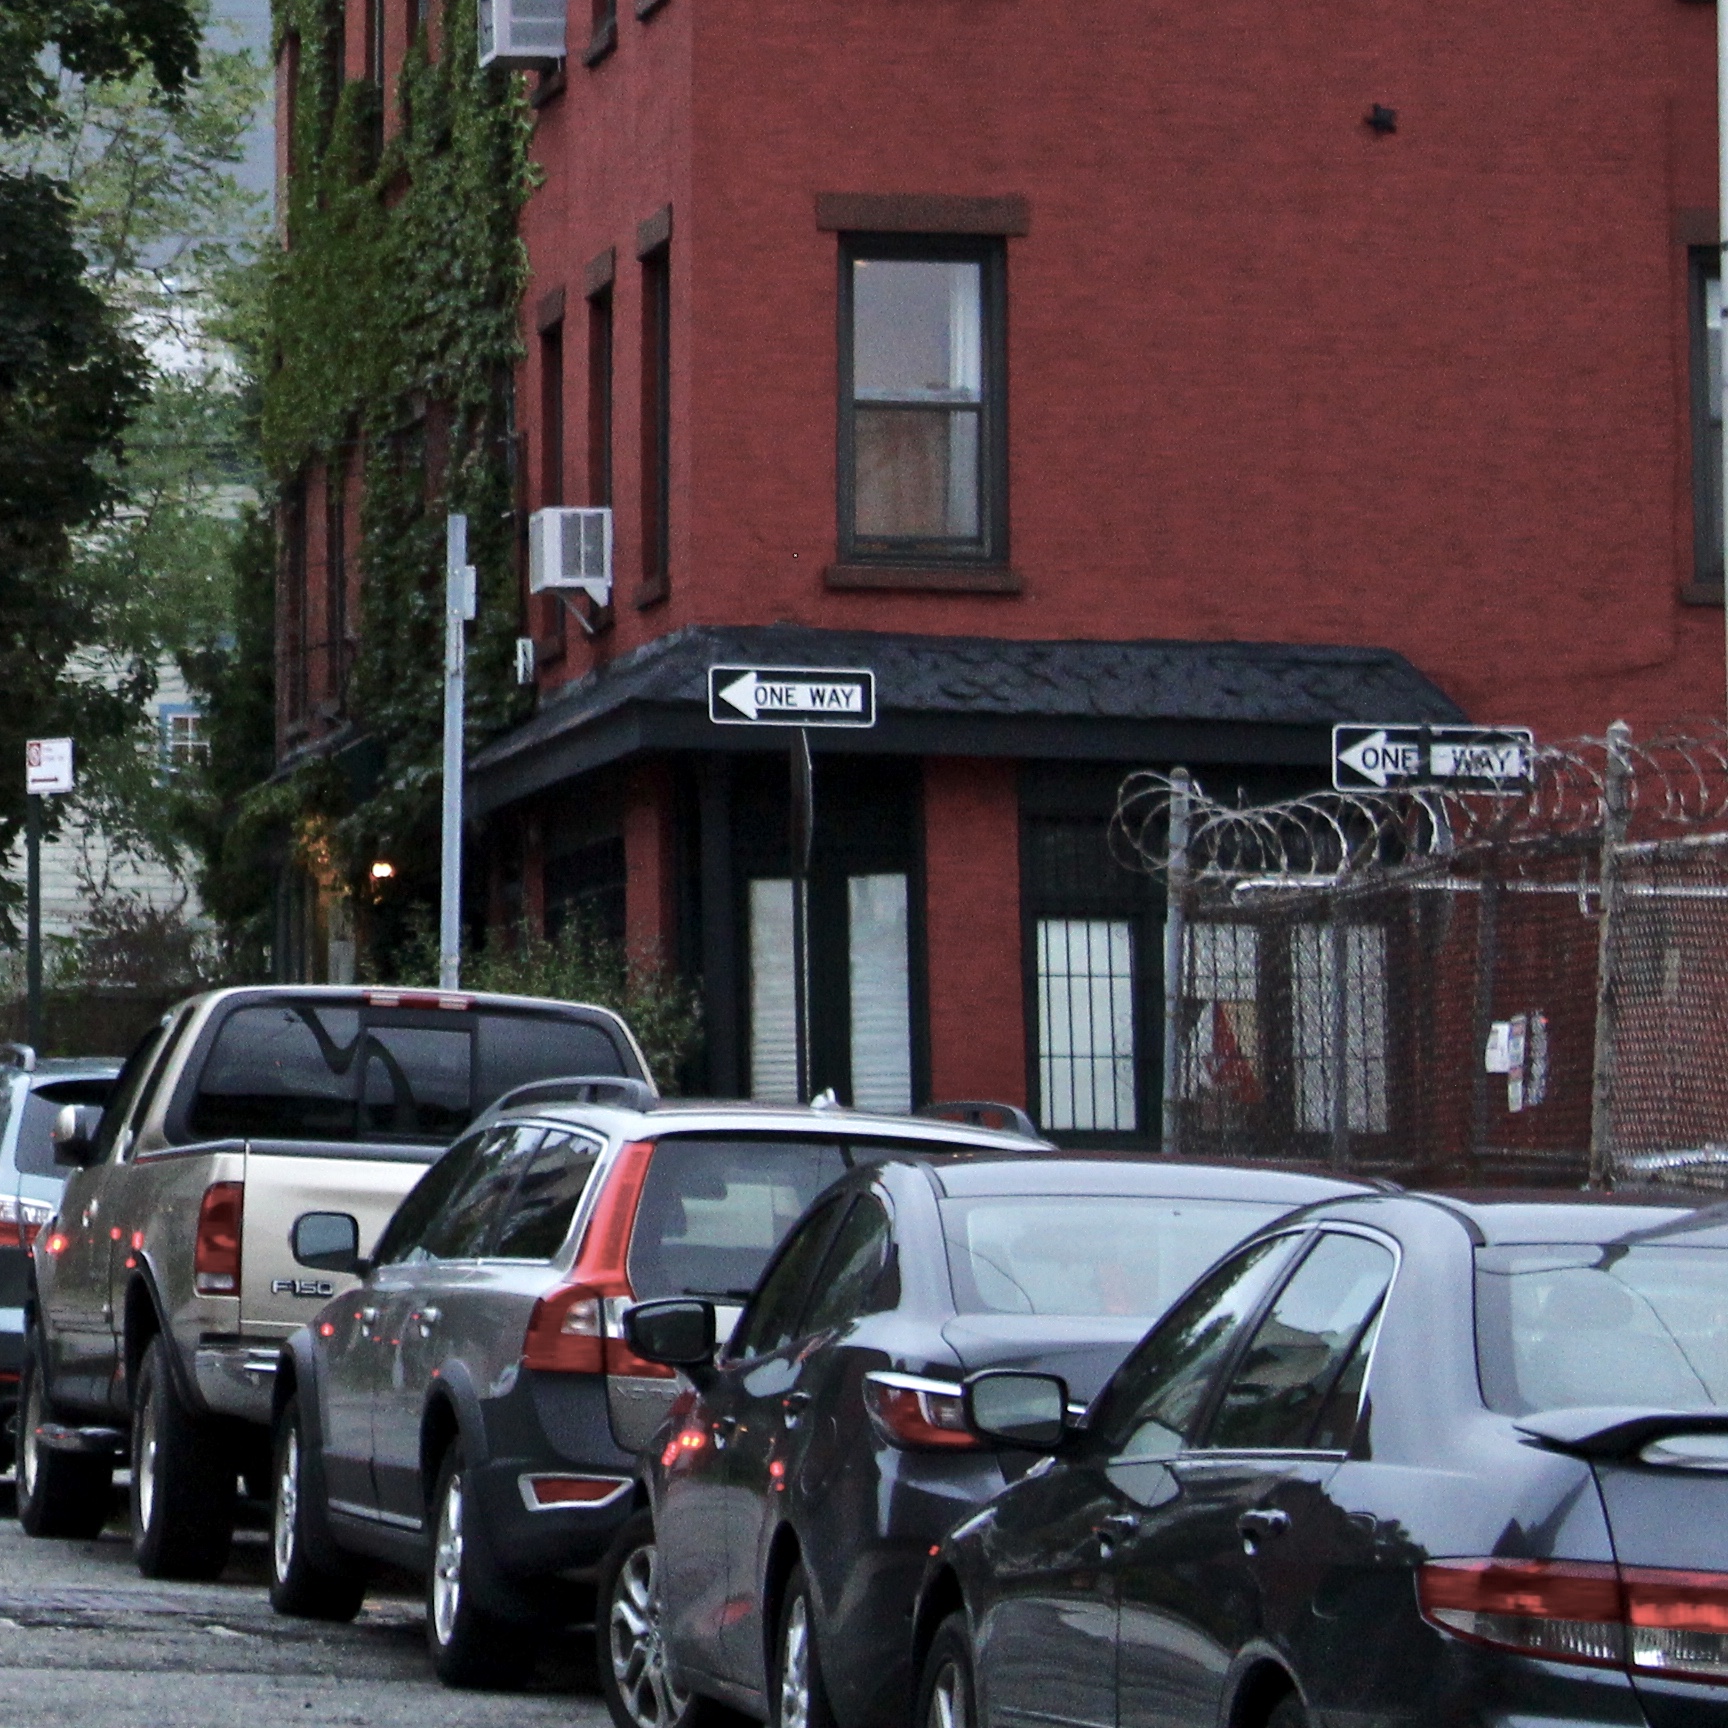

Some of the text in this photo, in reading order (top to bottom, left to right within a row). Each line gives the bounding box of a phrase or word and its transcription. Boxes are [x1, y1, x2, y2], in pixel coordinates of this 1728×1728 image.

[754, 685, 855, 710] ONE WAY
[1361, 746, 1512, 773] ONE WAY
